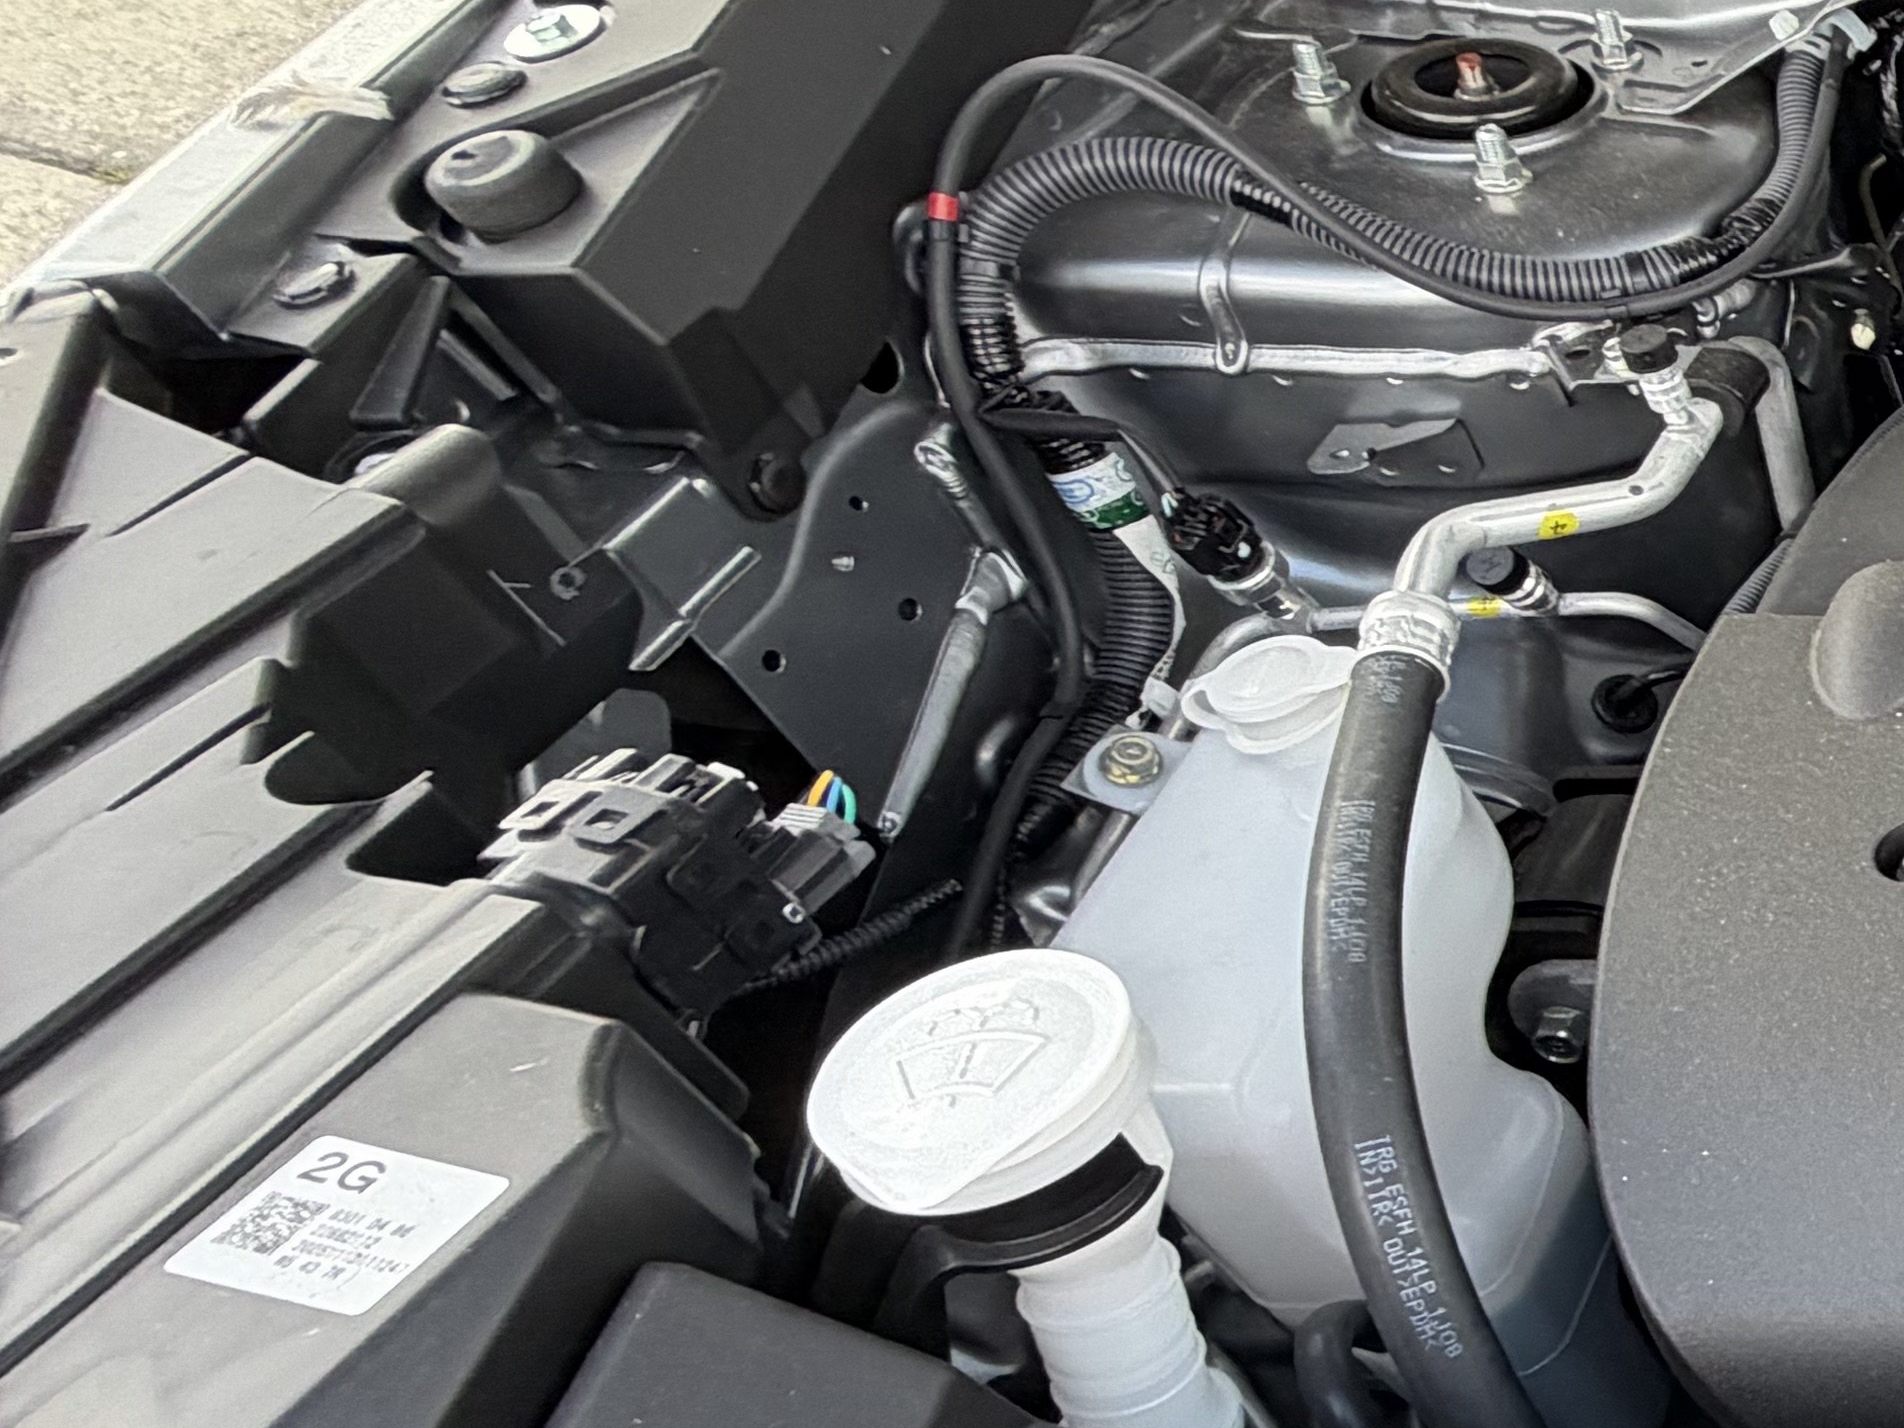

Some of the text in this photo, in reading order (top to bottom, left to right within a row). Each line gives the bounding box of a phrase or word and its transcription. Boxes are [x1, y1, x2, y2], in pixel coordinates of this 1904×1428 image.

[297, 1152, 387, 1194] 2G
[1385, 1183, 1418, 1236] ESFH
[1406, 1246, 1438, 1295] 14LP
